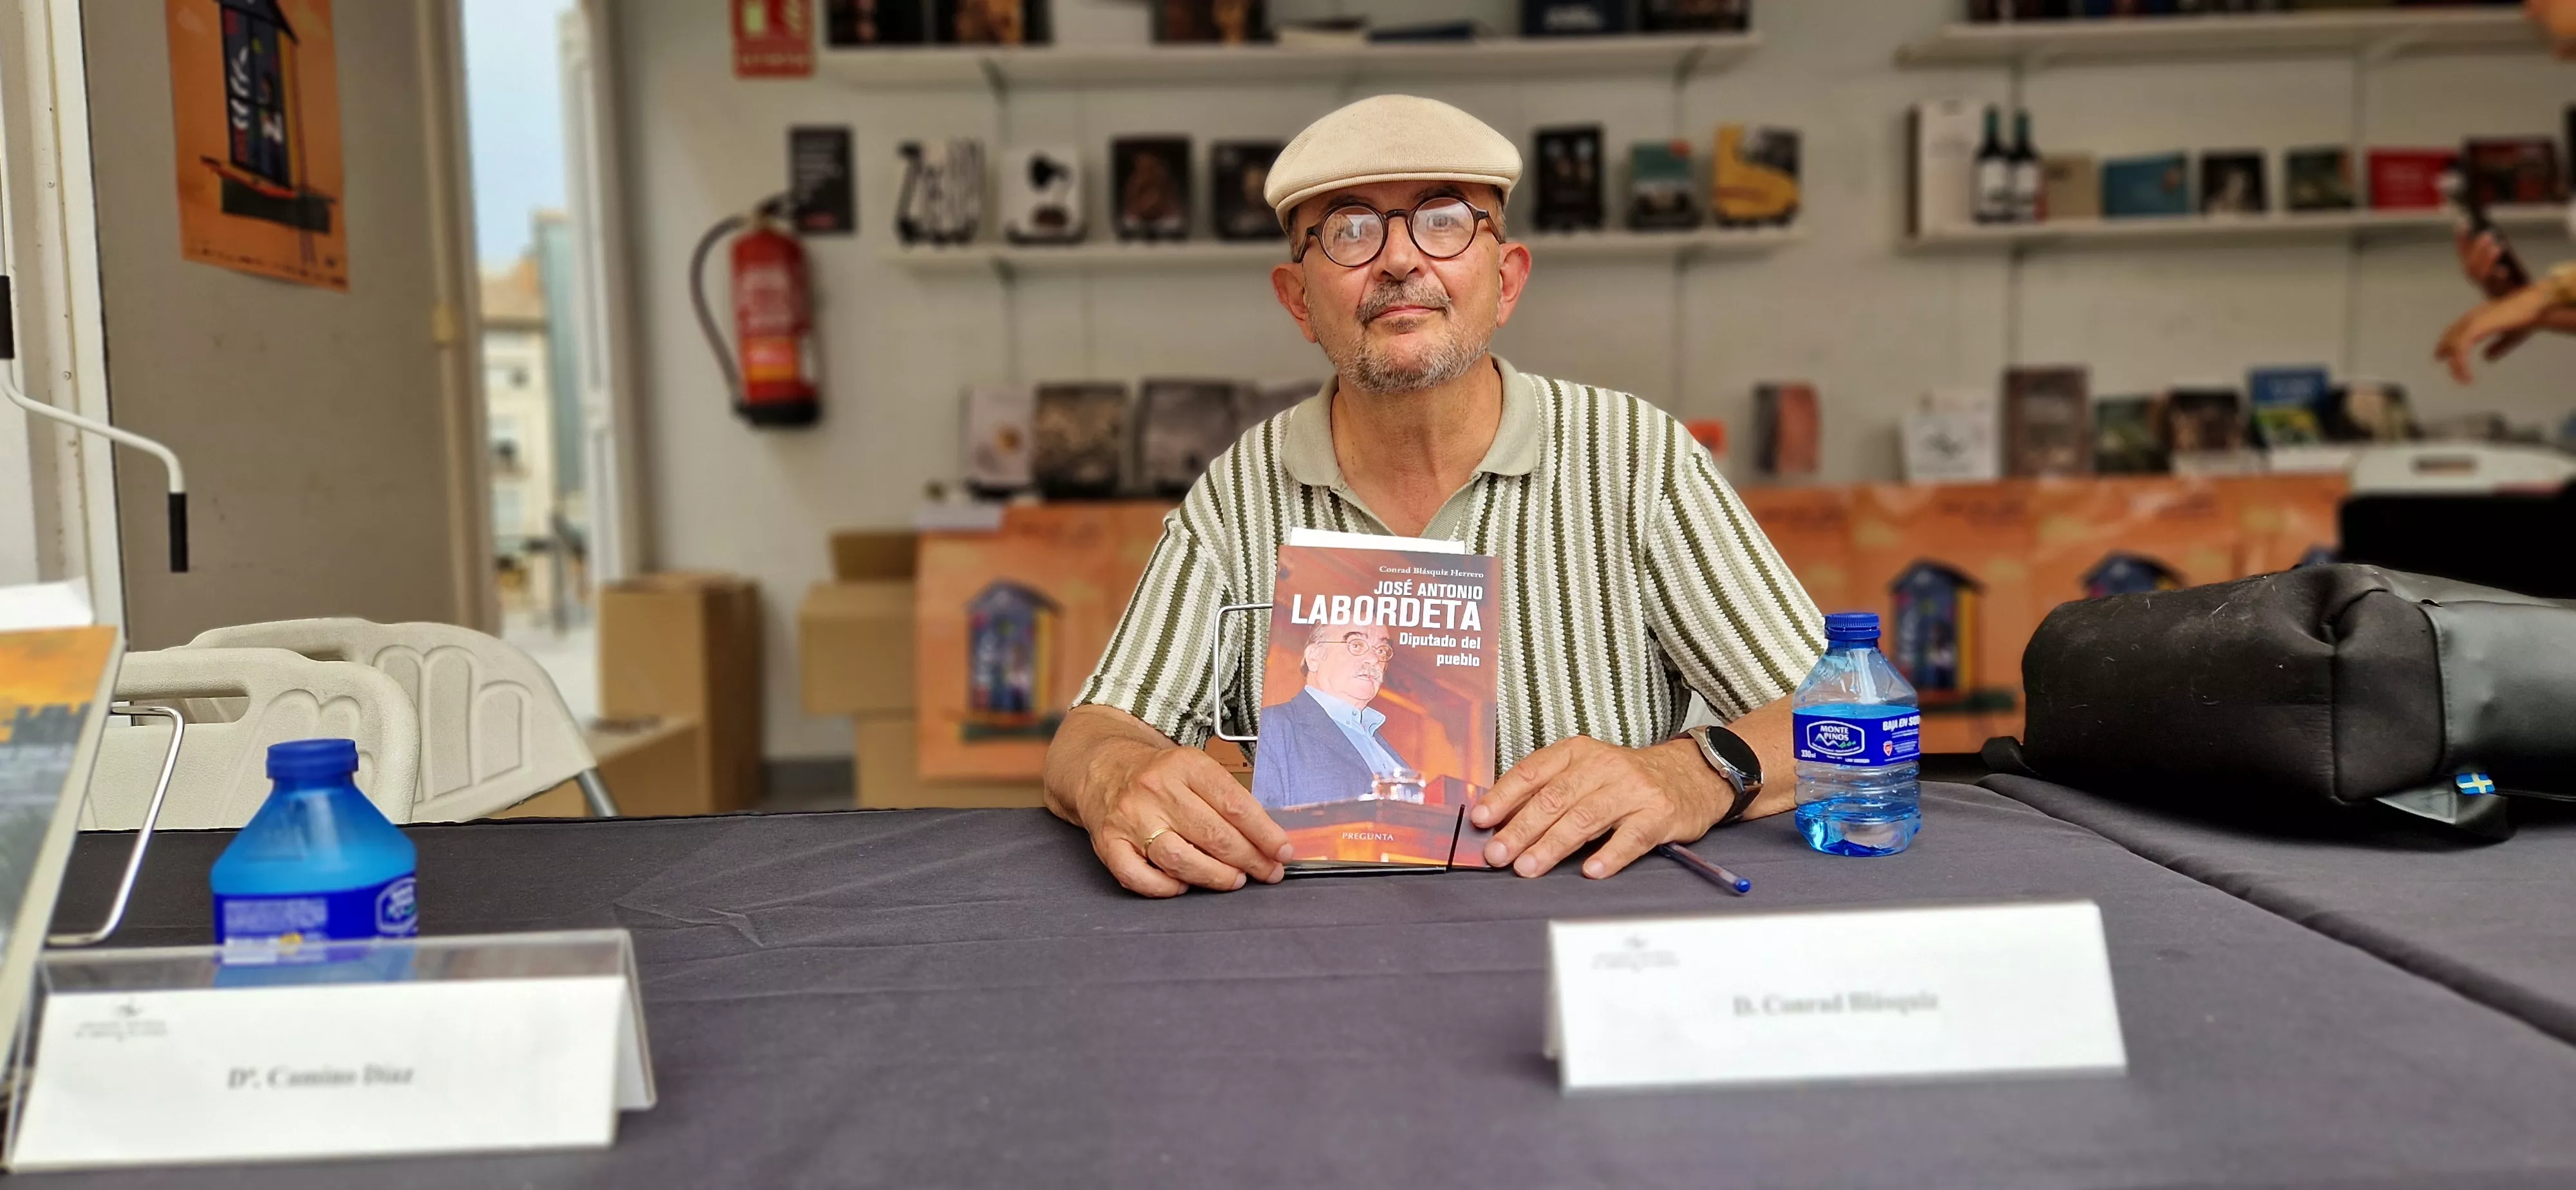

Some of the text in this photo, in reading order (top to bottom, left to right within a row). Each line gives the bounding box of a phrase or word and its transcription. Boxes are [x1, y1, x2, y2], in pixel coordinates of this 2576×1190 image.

[1414, 567, 1448, 577] Blásquiz
[1450, 569, 1484, 578] Herrero
[1374, 579, 1483, 600] JOSÉ ANTONIO
[1291, 594, 1482, 631] LABORDETA
[1399, 632, 1481, 649] Diputado del
[1436, 652, 1481, 666] pueblo
[1820, 725, 1849, 735] MONTE
[1882, 719, 1898, 732] BAJA
[1899, 717, 1908, 728] EN
[1824, 732, 1850, 741] PINOS
[1341, 832, 1394, 841] PREGUNTA
